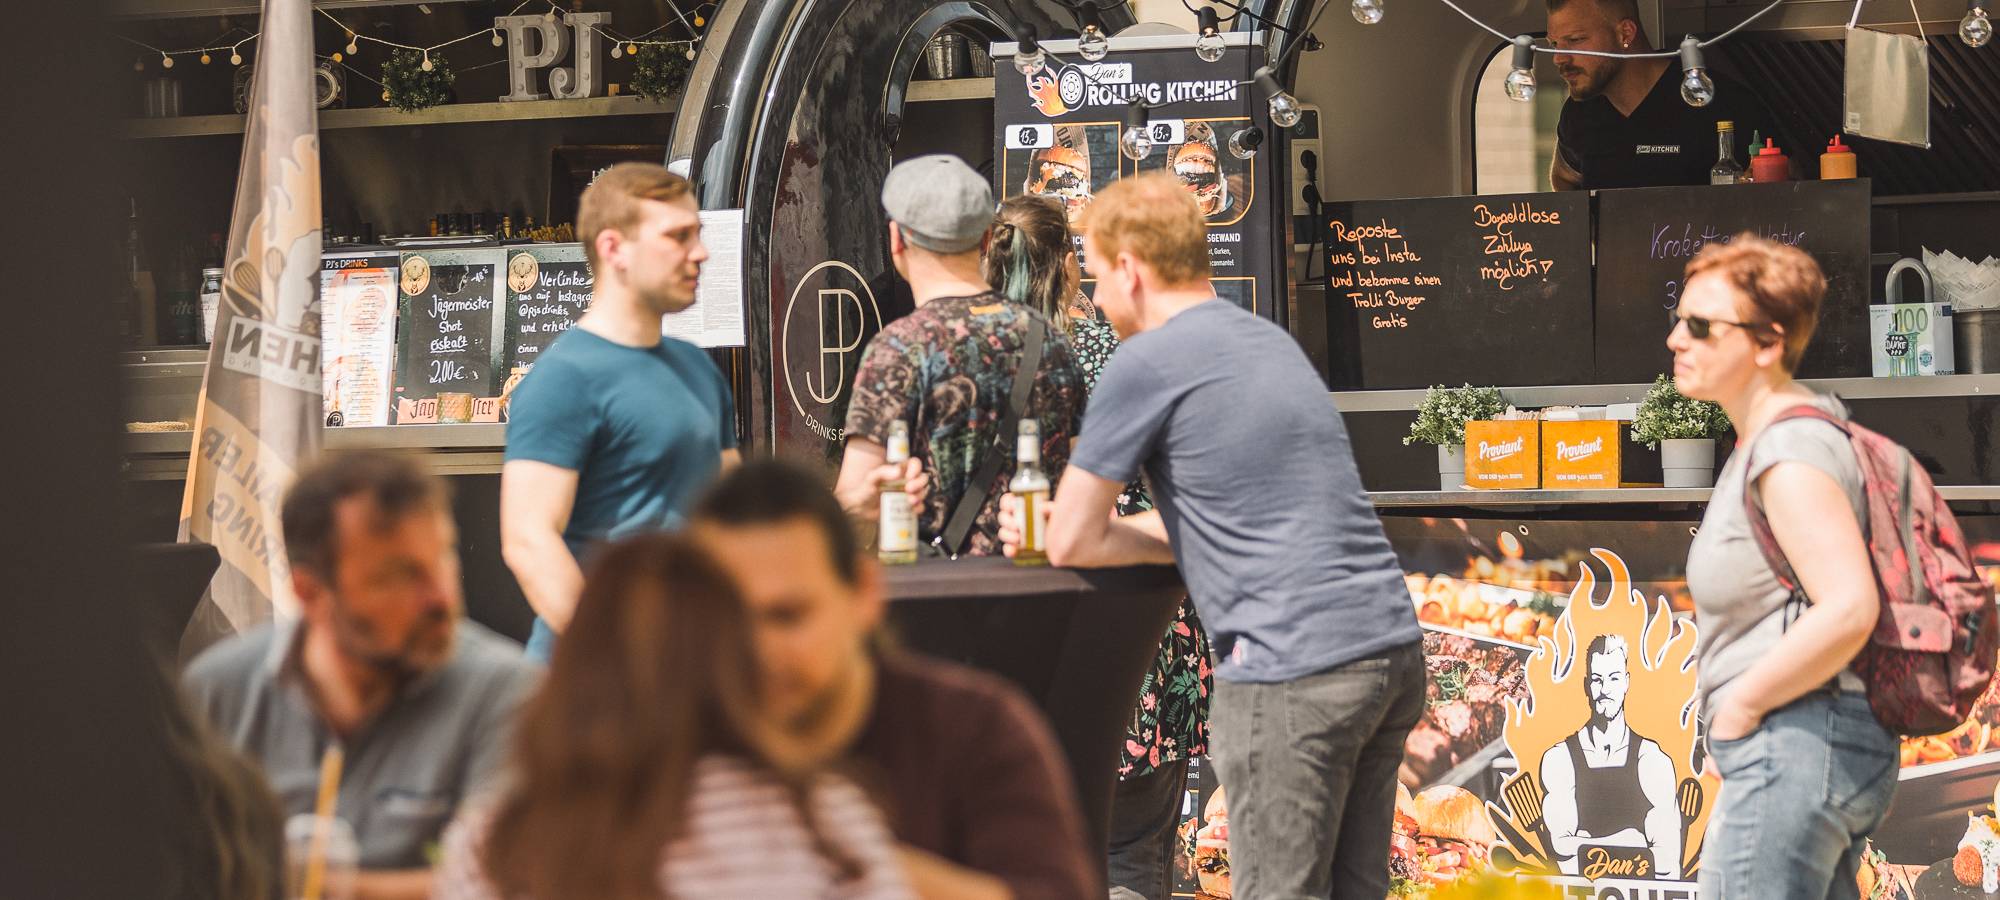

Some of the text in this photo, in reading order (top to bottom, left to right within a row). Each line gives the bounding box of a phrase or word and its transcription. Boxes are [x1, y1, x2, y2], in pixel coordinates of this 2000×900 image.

[495, 12, 612, 102] PJ
[1091, 63, 1125, 82] Dan's
[1088, 80, 1237, 106] ROLLING KITCHEN
[1651, 145, 1679, 153] KITCHEN
[1207, 233, 1241, 243] SGEWAND
[1330, 218, 1401, 250] Reposte
[1332, 241, 1421, 265] uns bei Insta
[340, 259, 369, 269] DRINKS
[1332, 270, 1441, 288] und bekomme einen
[428, 294, 493, 320] Jägermeister
[558, 290, 593, 307] Instagra
[1347, 289, 1425, 310] Trolli Burger
[439, 320, 463, 334] Shot
[521, 322, 537, 333] und
[1373, 313, 1407, 329] Gratis
[1893, 308, 1928, 332] 100
[430, 335, 468, 350] eiskalt
[1886, 341, 1907, 350] DANKE
[805, 413, 837, 441] DRINKS
[1479, 437, 1523, 461] Proviant
[1556, 437, 1602, 461] Proviant
[1584, 848, 1650, 881] Dan's
